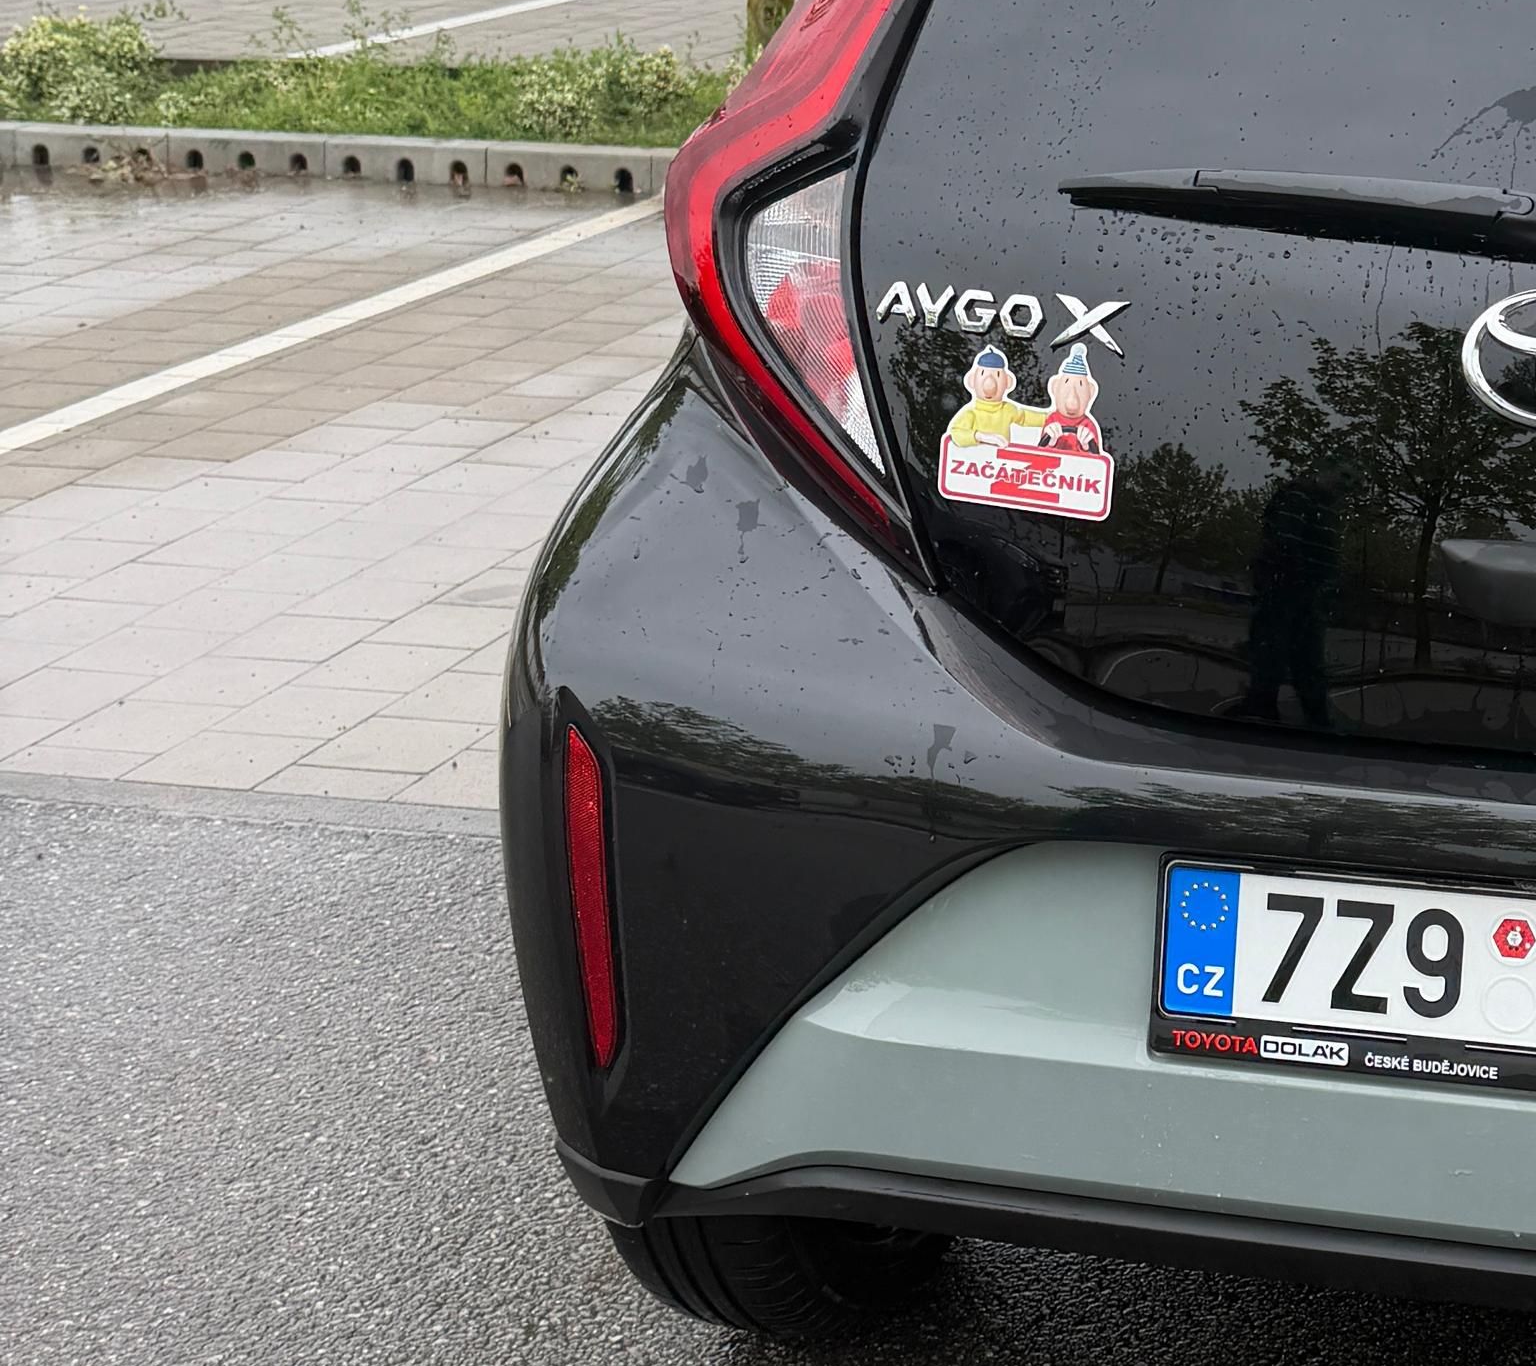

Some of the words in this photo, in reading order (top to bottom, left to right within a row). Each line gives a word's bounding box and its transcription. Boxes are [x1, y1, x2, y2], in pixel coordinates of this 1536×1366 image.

[875, 281, 1044, 339] AYGO
[1049, 292, 1132, 357] X
[950, 459, 1103, 495] ZAČÁTEČNÍK
[1262, 892, 1465, 1019] 7Z9
[1176, 963, 1225, 998] CZ
[1171, 1029, 1259, 1055] TOYOTA
[1364, 1051, 1410, 1071] ČESKÉ
[1412, 1059, 1499, 1080] BUDĚJOVICE
